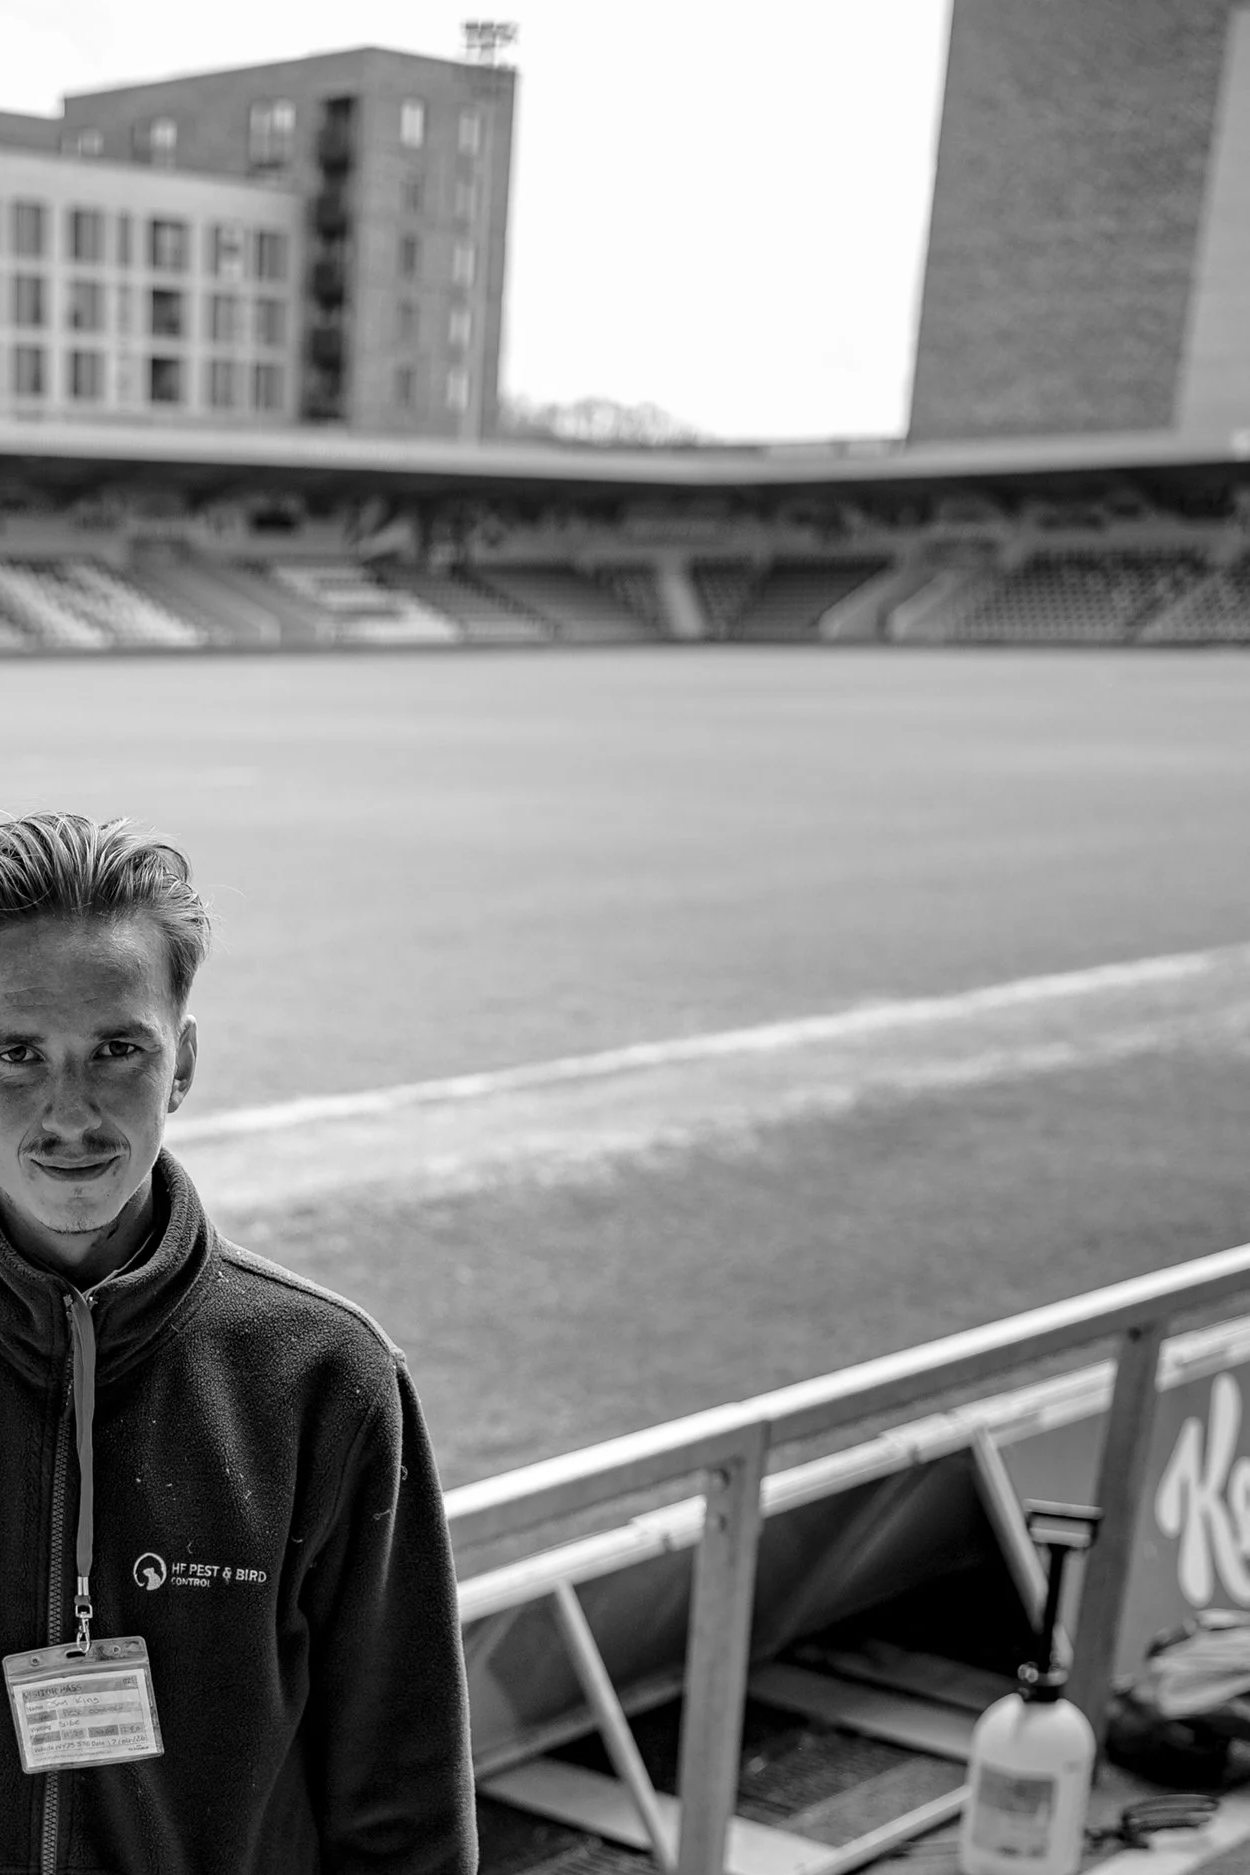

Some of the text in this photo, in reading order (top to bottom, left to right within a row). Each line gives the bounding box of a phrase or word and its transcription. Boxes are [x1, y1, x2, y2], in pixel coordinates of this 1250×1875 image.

[171, 1562, 267, 1583] HF PEST & BIRD
[171, 1576, 211, 1588] CONTROL
[22, 1683, 82, 1699] VISITOR PASS
[75, 1695, 100, 1706] King
